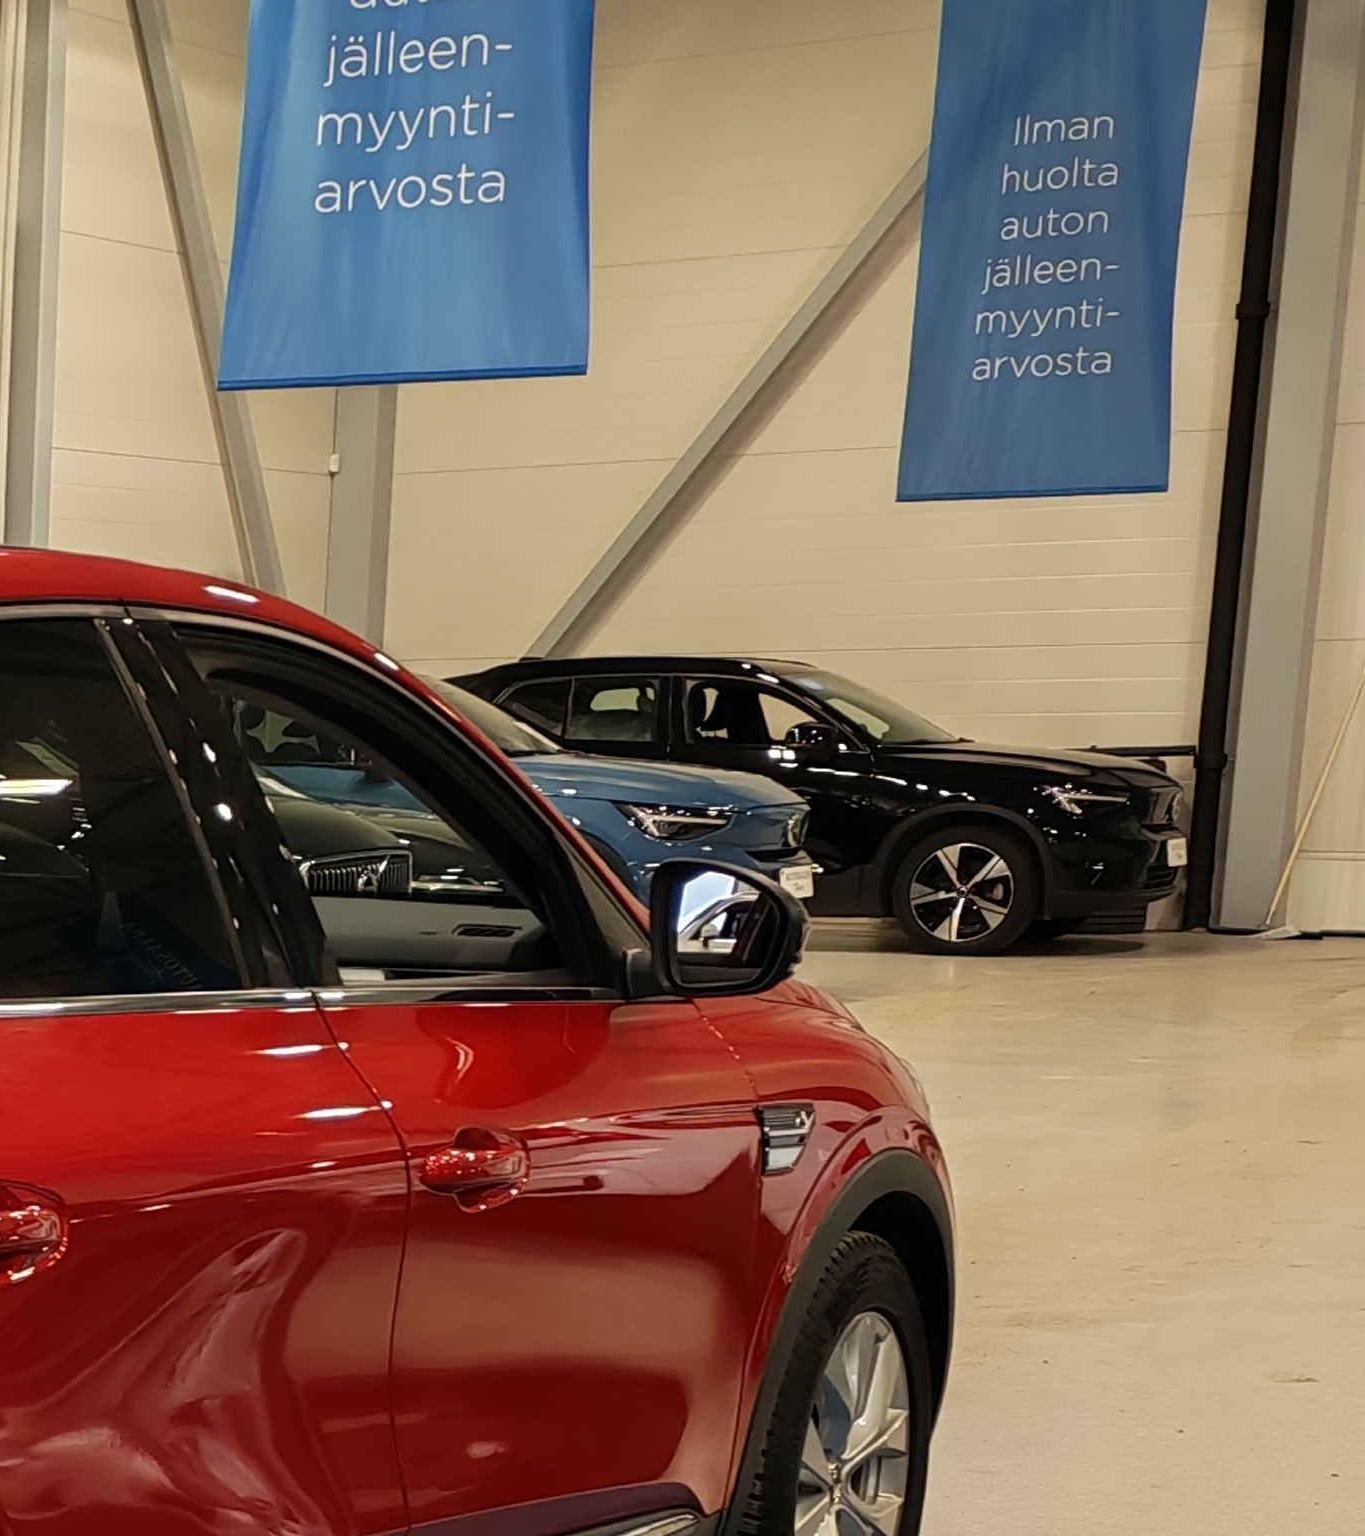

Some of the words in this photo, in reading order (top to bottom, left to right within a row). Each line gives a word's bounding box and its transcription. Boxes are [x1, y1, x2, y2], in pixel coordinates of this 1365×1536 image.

[323, 31, 513, 88] jälleen-
[316, 91, 515, 153] myynti-
[1013, 113, 1115, 147] Ilman
[314, 163, 506, 213] arvosta
[1001, 156, 1119, 194] huolta
[1000, 208, 1109, 240] auton
[981, 254, 1119, 294] jälleen-
[975, 298, 1120, 338] myynti-
[972, 346, 1113, 381] arvosta
